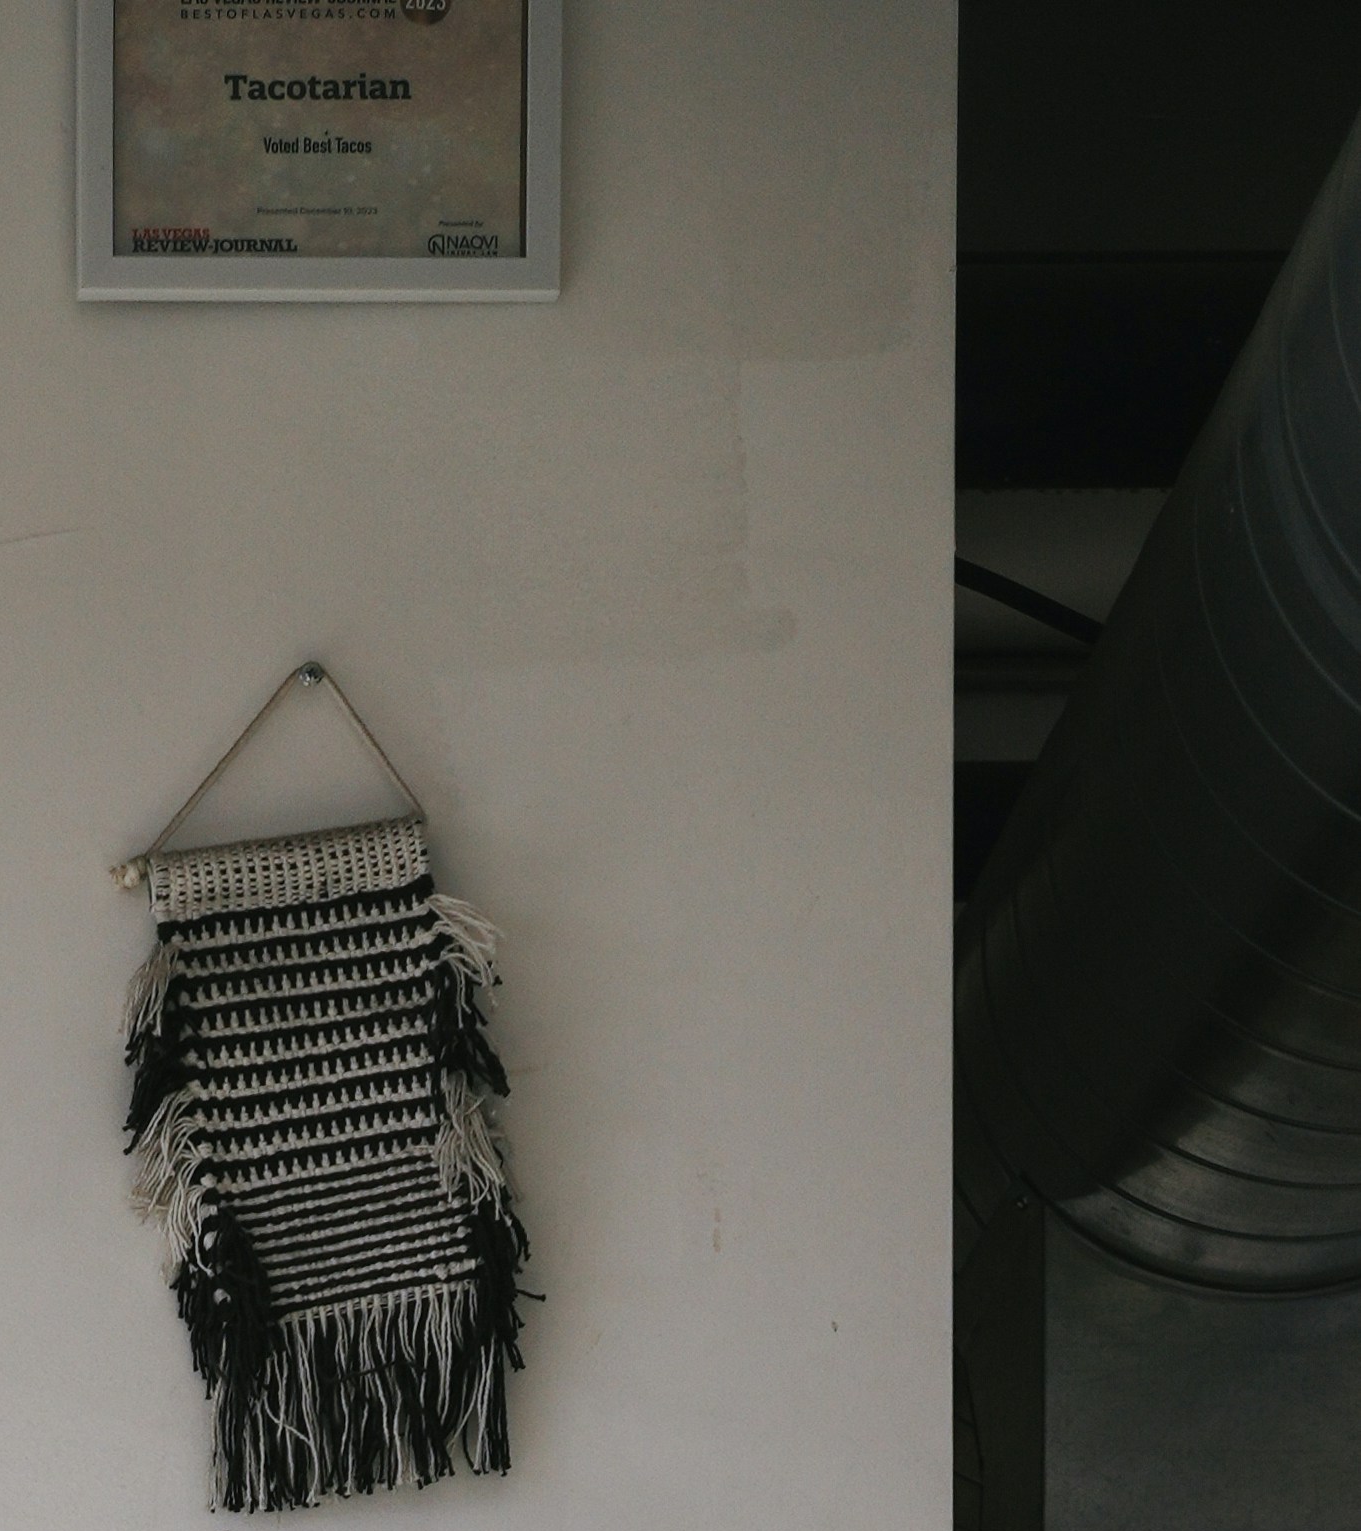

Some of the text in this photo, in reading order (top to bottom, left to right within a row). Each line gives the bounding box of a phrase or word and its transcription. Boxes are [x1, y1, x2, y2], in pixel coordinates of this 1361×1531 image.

[181, 8, 395, 19] BESTOFLASVEGAS.COM
[224, 73, 412, 100] Tacotarian
[264, 137, 371, 153] Voted Best Tacos
[132, 228, 209, 242] LAS VEGAS
[132, 237, 297, 254] REVIEW-JOURNAL
